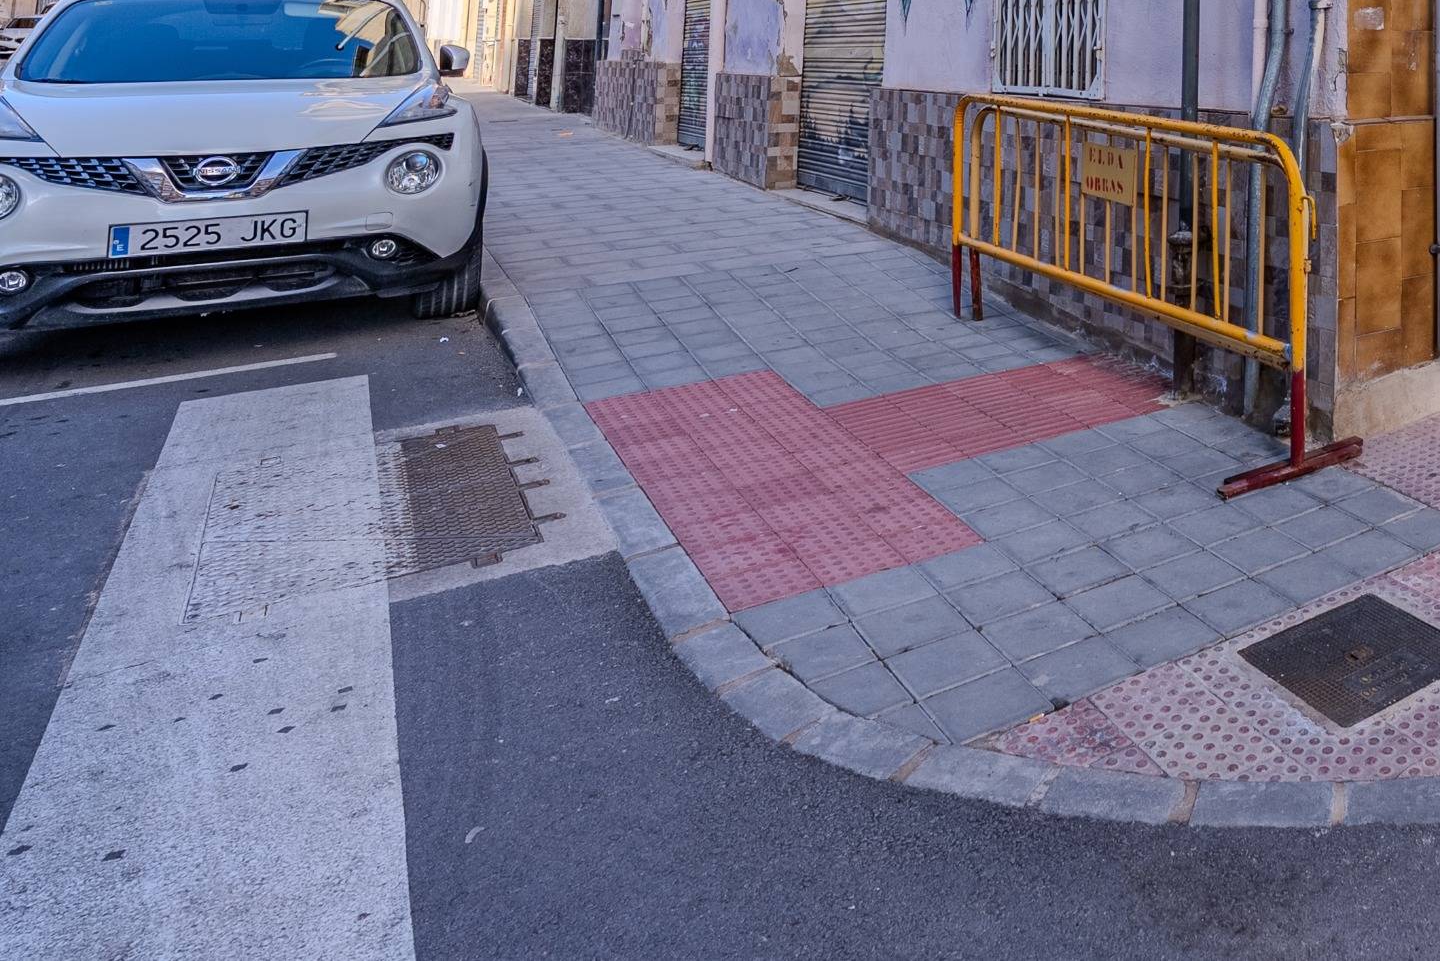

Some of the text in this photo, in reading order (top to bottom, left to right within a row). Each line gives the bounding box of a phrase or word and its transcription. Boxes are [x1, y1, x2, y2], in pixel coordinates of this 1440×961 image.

[1088, 147, 1123, 170] ELDA
[196, 166, 240, 175] NISSAN
[1086, 176, 1123, 195] OBRAS
[140, 223, 221, 251] 2525
[241, 218, 298, 243] JKG
